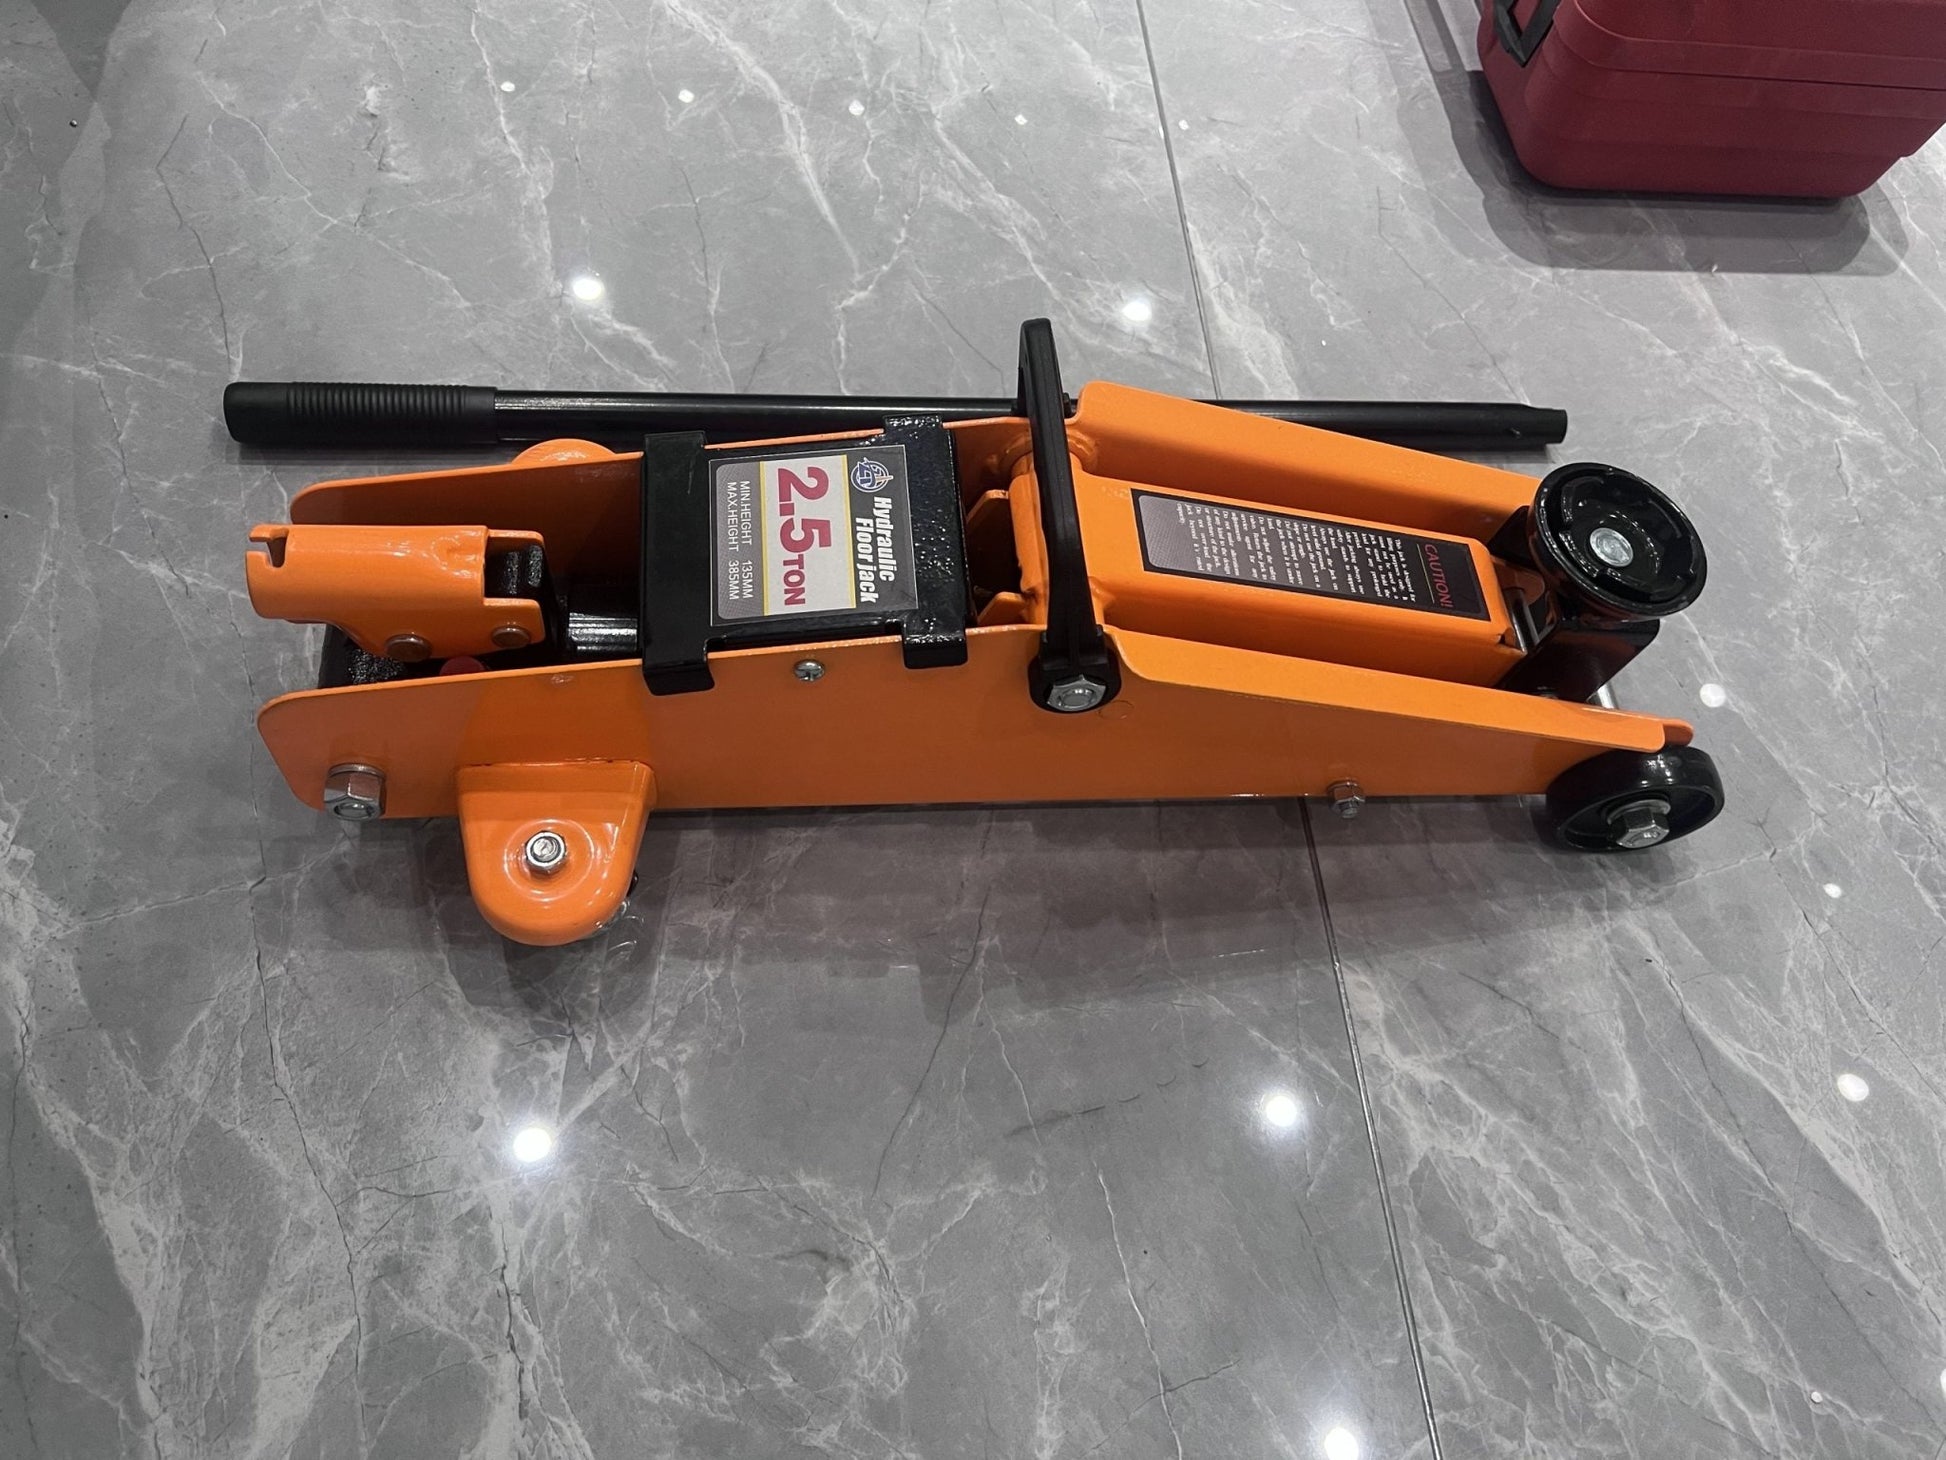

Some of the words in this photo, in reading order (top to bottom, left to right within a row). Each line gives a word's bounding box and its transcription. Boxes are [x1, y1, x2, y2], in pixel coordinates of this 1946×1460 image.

[727, 481, 740, 552] MAX.HEIGHT
[740, 480, 753, 546] MIN.HEIGHT
[855, 517, 875, 561] Floor
[873, 496, 898, 582] Hydraulic
[728, 559, 740, 600] 385MM
[741, 559, 754, 599] 135MM
[856, 563, 880, 603] jack
[1424, 543, 1455, 610] CAUTION!
